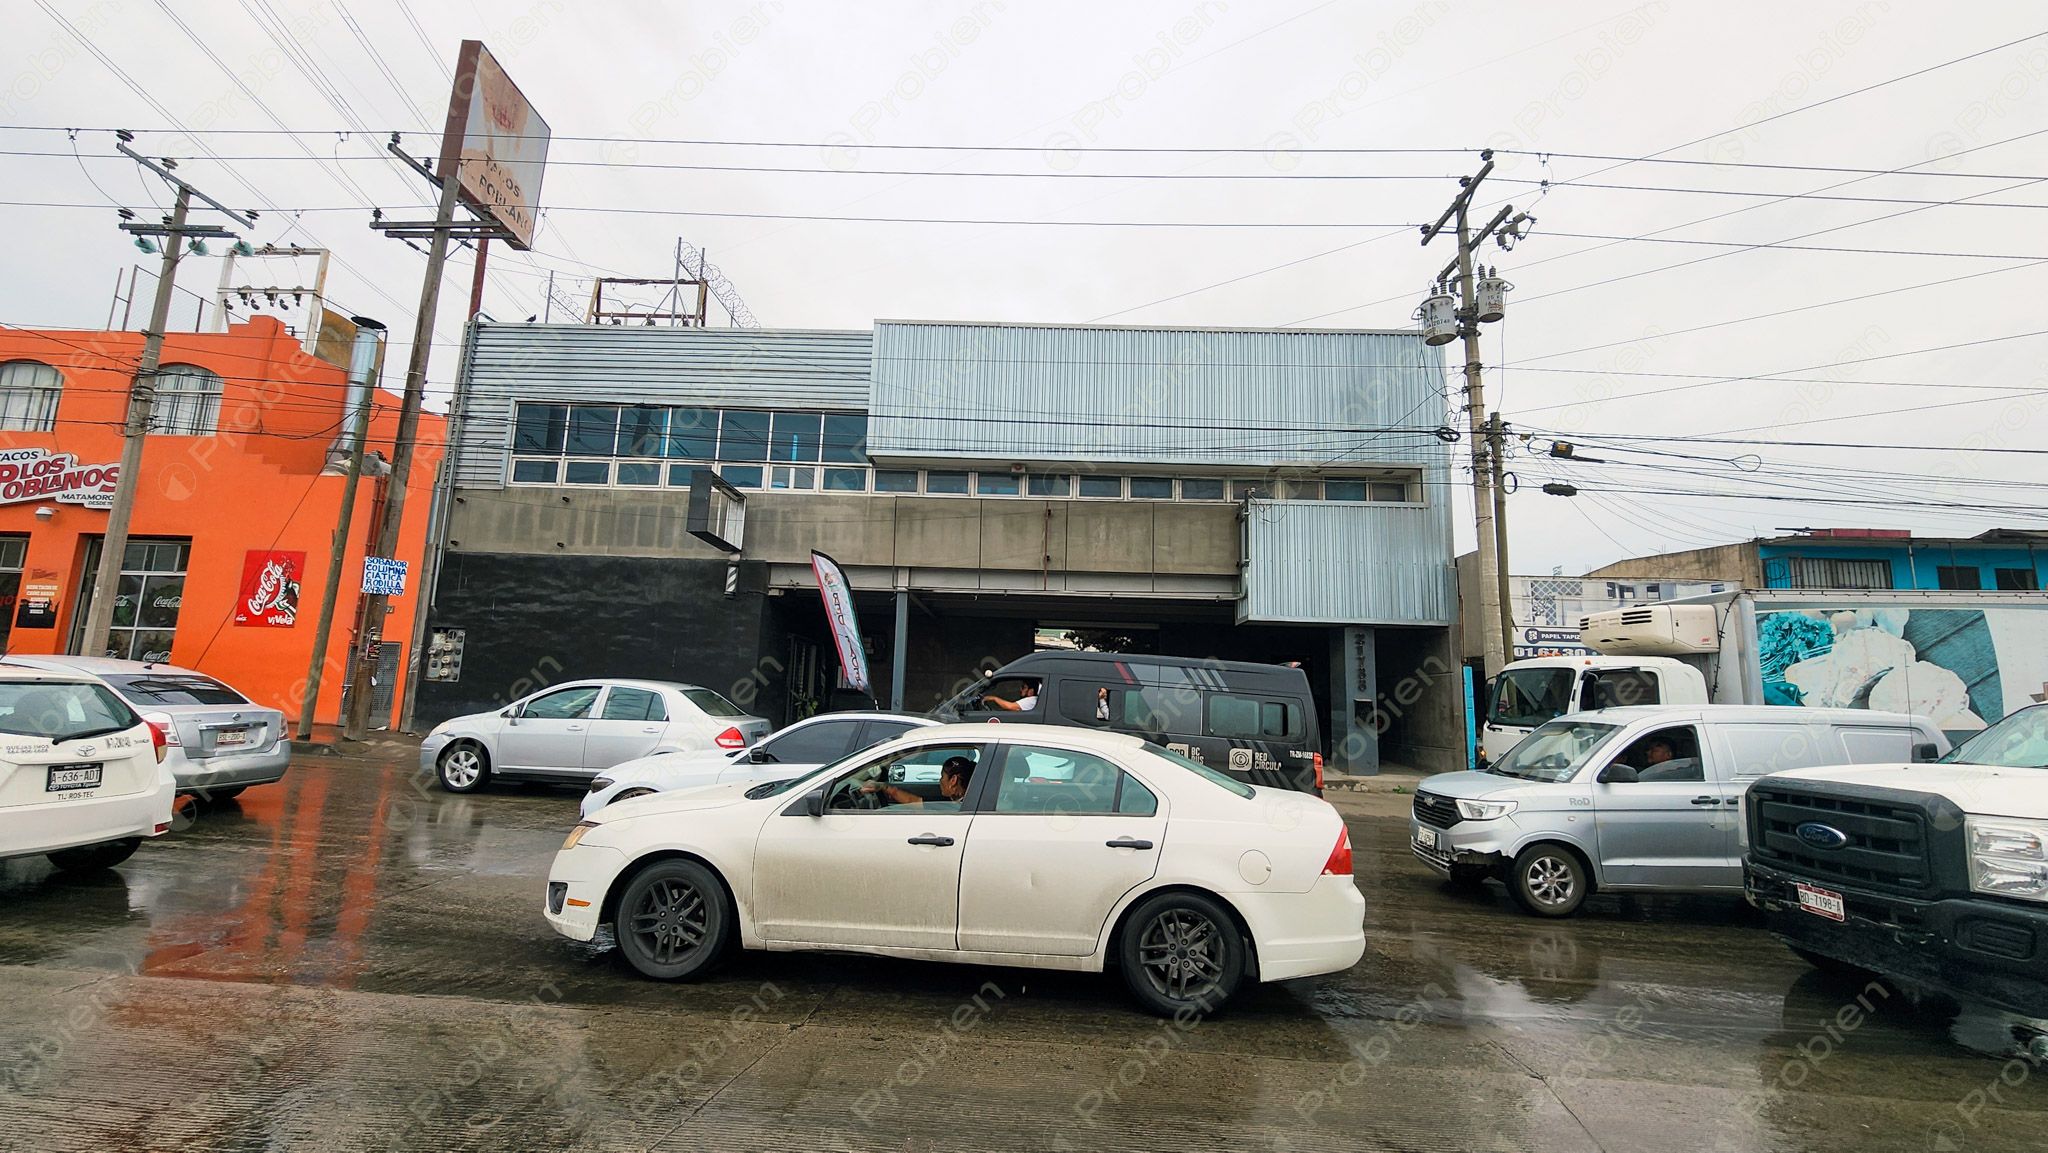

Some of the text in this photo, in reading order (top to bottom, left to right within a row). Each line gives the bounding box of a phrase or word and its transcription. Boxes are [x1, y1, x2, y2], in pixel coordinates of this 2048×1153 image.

[366, 557, 408, 568] SOBADOR
[366, 564, 407, 576] COLUMNA
[366, 572, 402, 582] CIATICA
[365, 579, 402, 589] RODILLA
[51, 769, 101, 783] A-636-ADT
[1569, 797, 1591, 806] RoD
[1804, 827, 1830, 842] Ford
